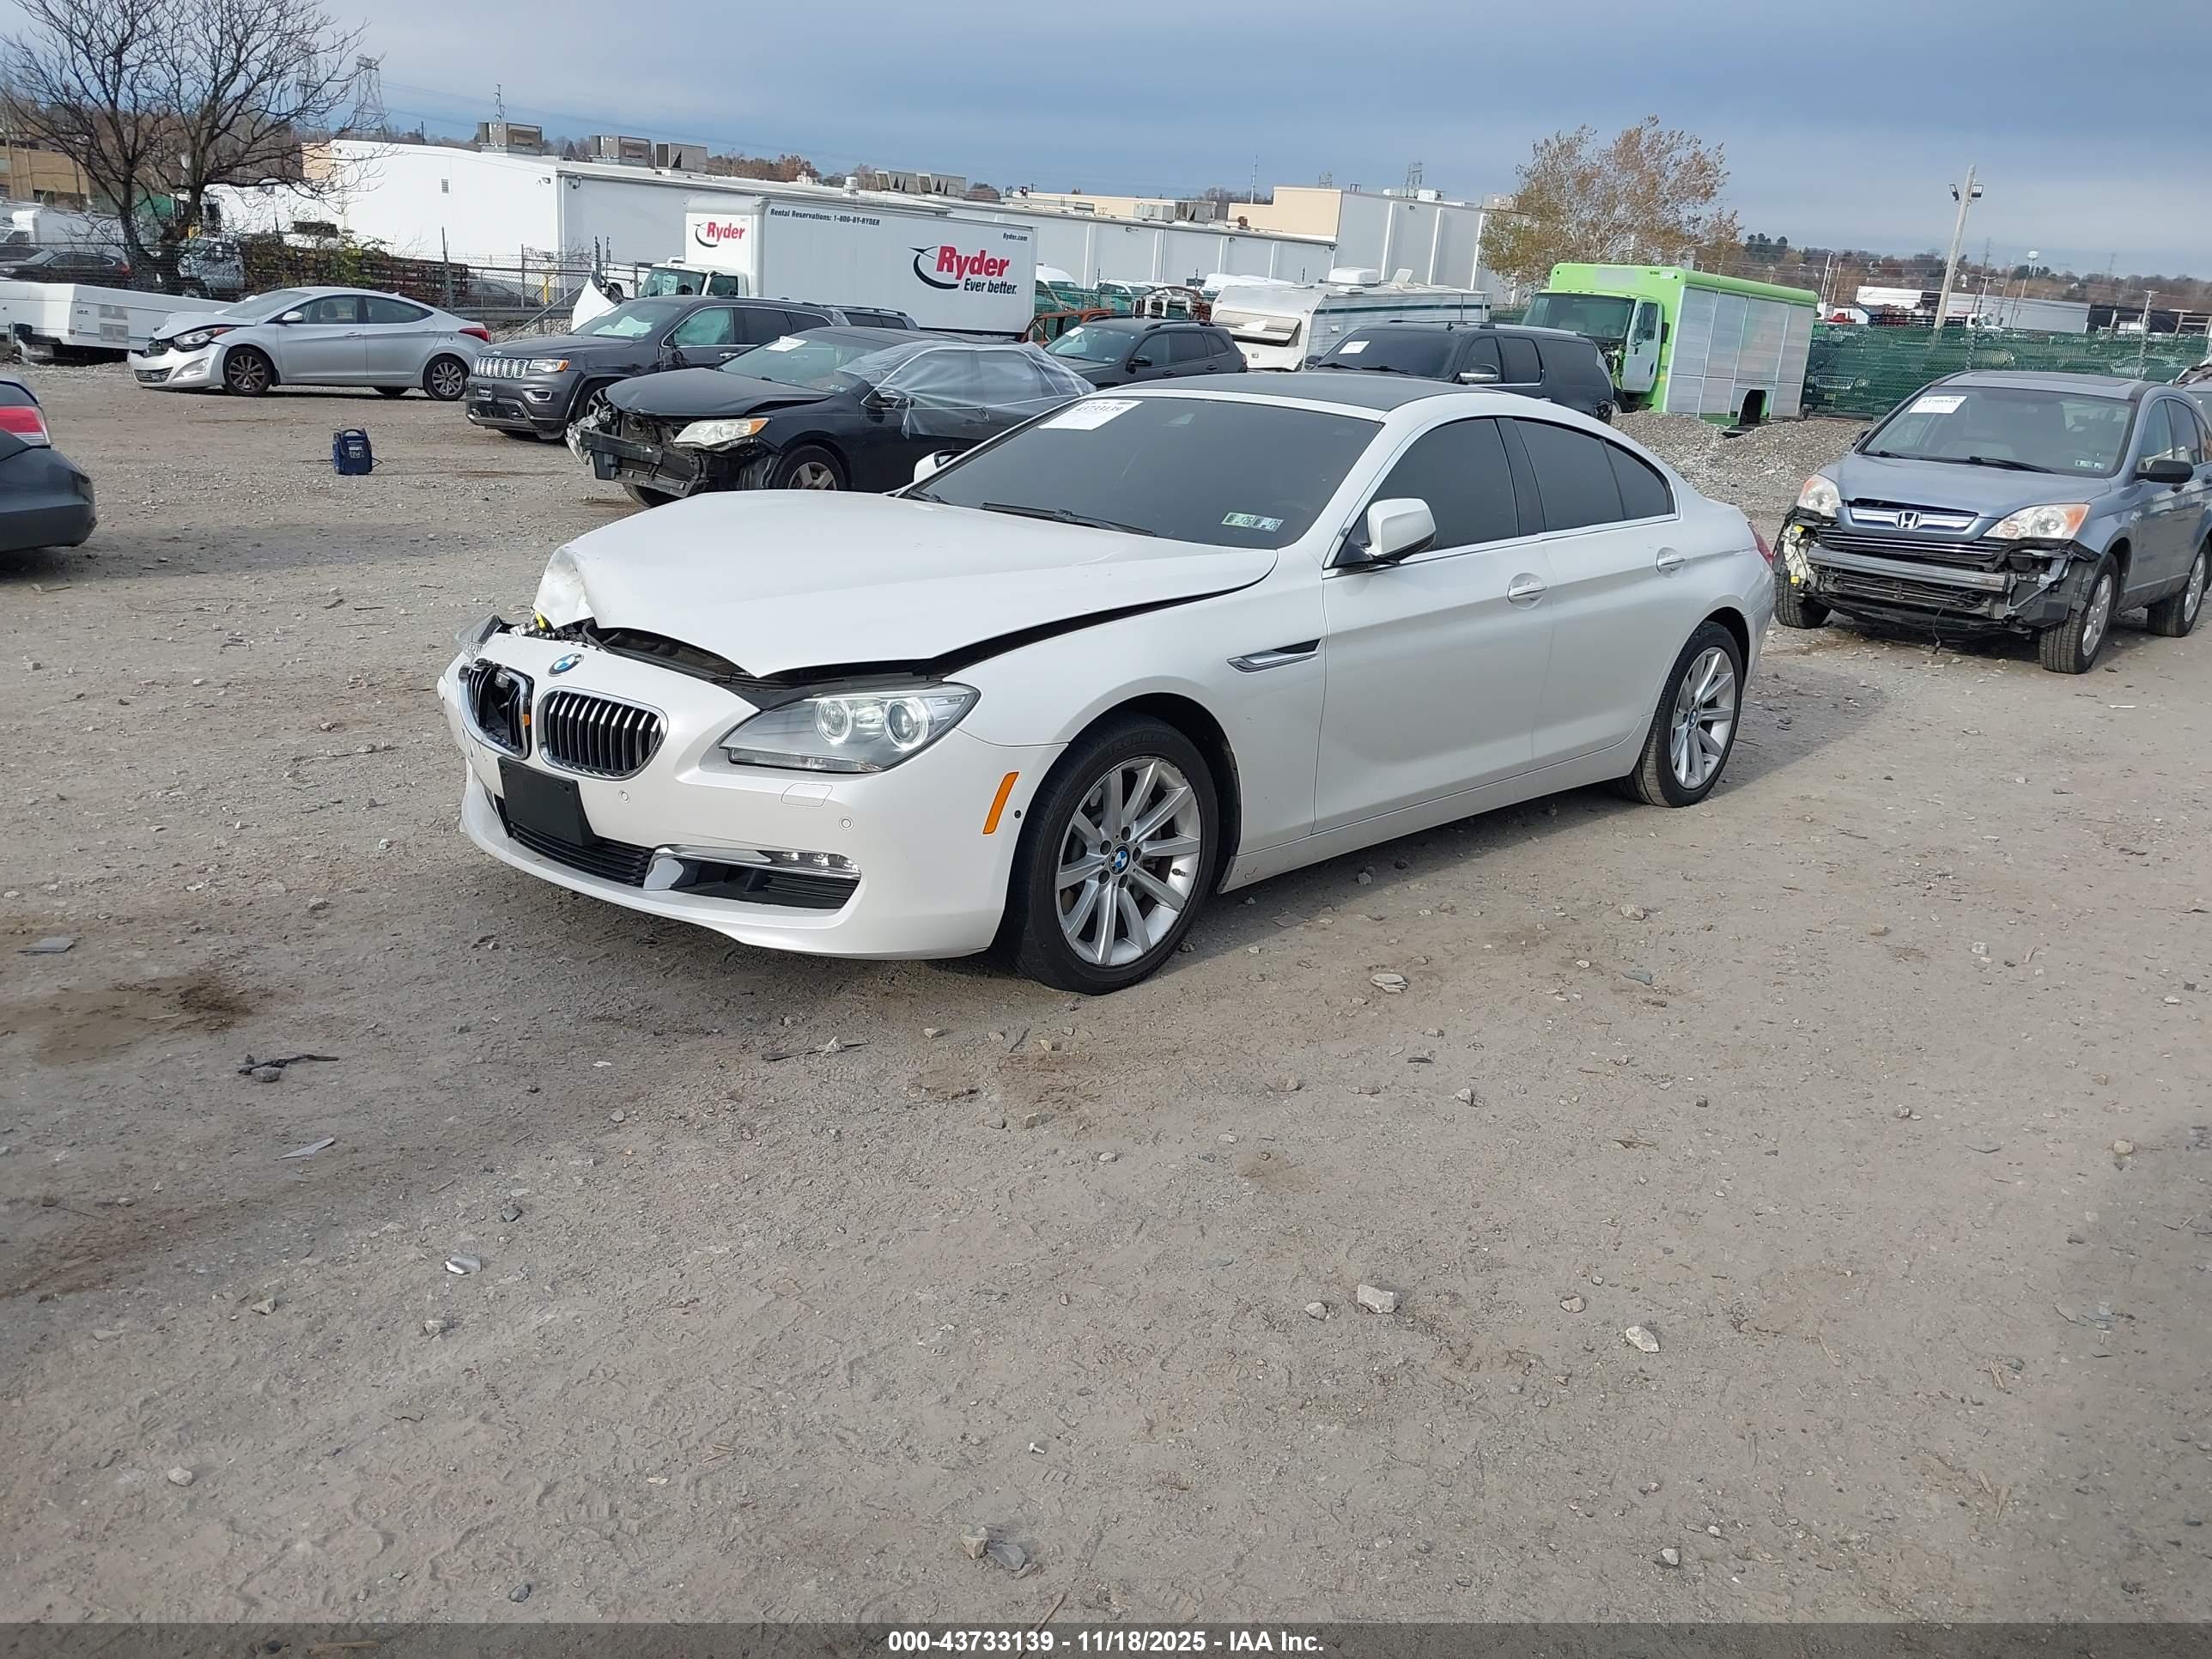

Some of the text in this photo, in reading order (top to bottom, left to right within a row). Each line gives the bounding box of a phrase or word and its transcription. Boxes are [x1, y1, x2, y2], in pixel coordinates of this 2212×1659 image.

[770, 209, 880, 226] Rental Reservations: 1-800-BY-RYDER
[707, 222, 745, 242] Ryder
[1002, 233, 1028, 241] Ryder.com
[936, 246, 1010, 280] Ryder
[963, 277, 1018, 295] Ever better.
